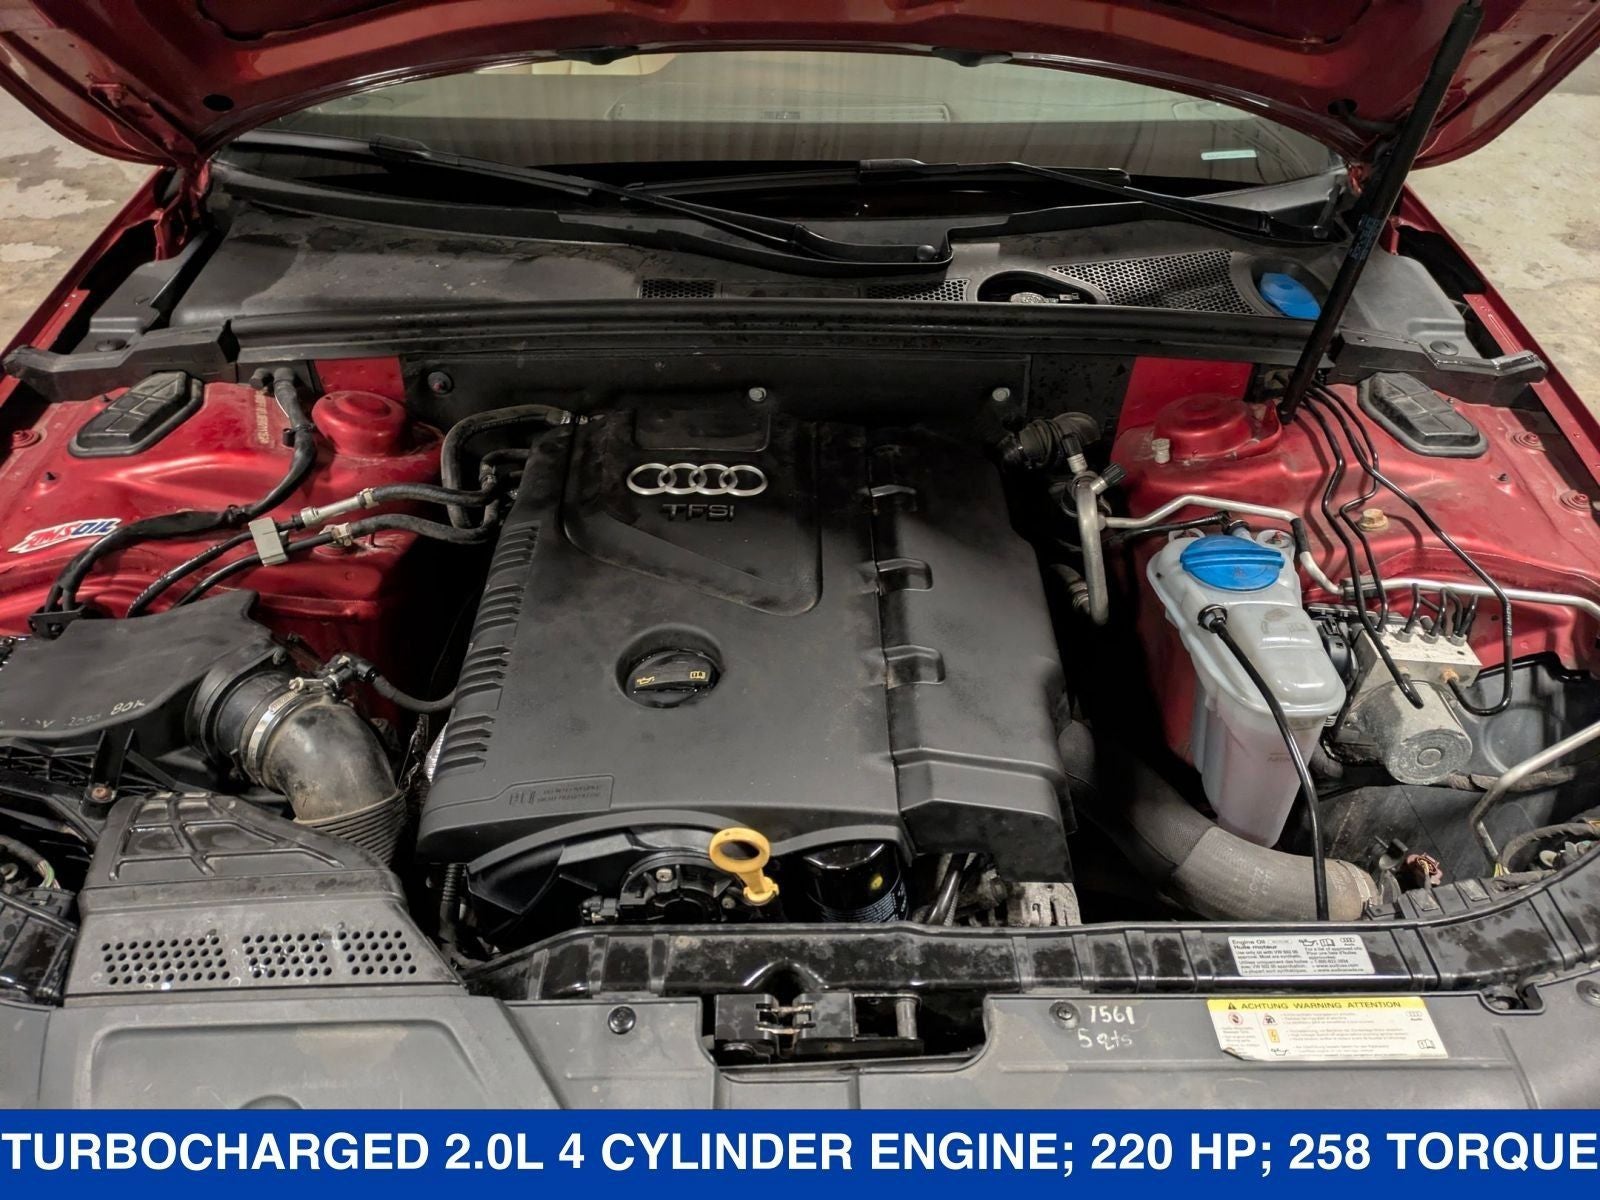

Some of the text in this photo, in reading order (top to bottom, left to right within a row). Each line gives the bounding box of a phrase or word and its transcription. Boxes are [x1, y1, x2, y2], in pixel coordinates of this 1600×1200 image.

[662, 503, 735, 522] TFSI
[1241, 1002, 1289, 1010] ACHTUNG
[1347, 1001, 1402, 1009] ATTENTION
